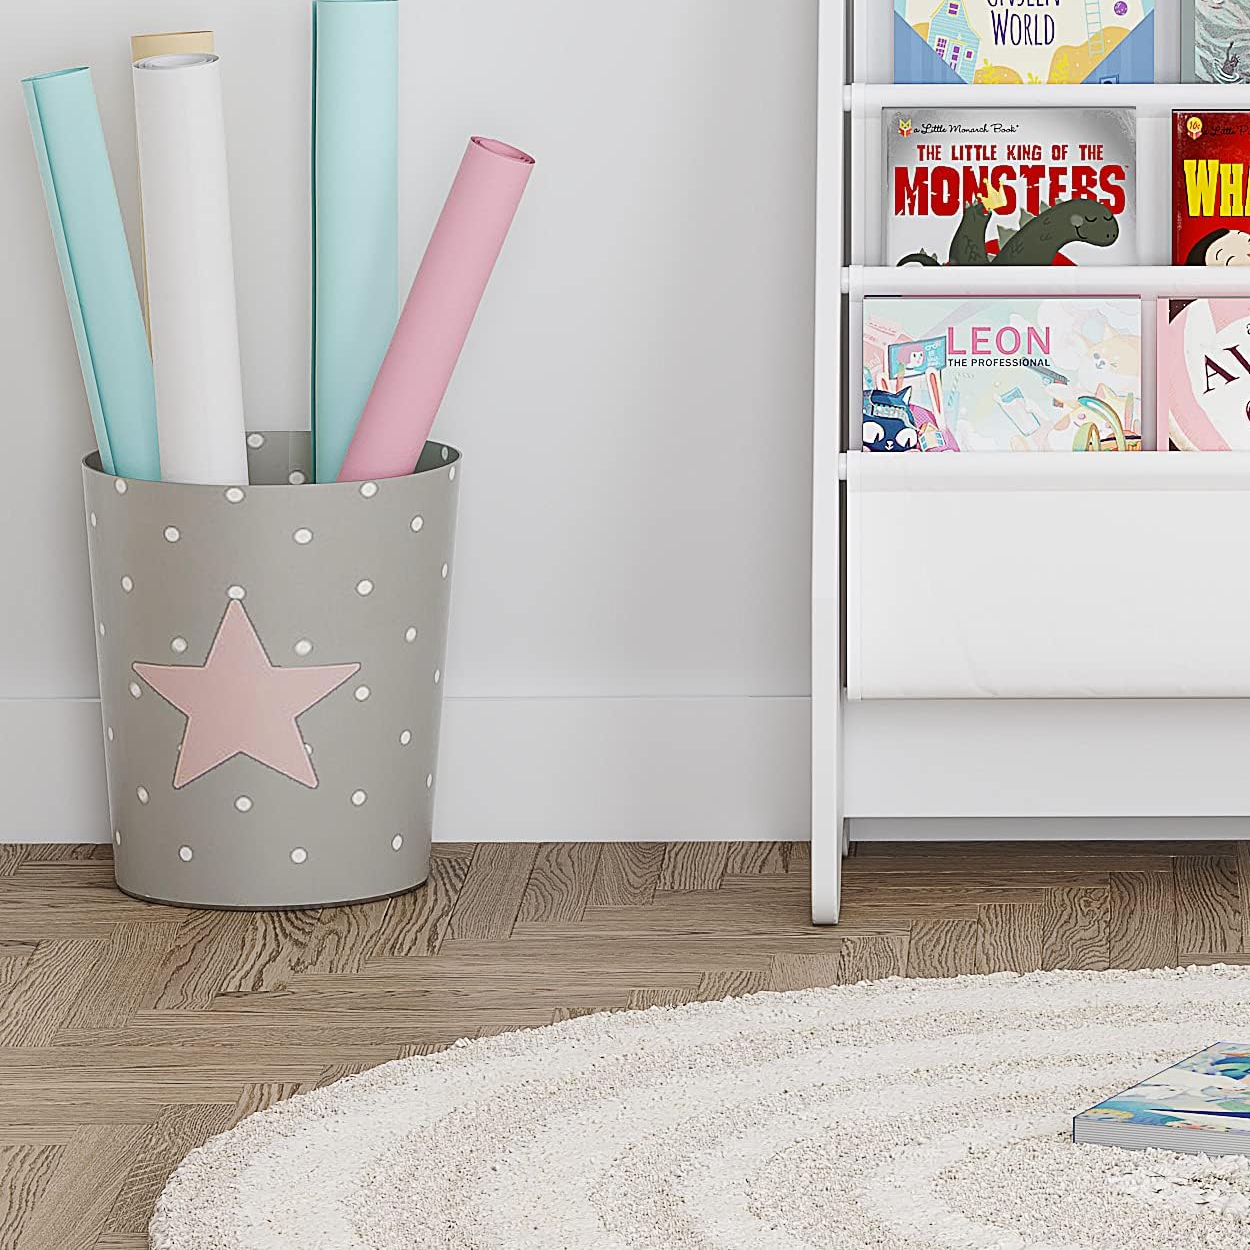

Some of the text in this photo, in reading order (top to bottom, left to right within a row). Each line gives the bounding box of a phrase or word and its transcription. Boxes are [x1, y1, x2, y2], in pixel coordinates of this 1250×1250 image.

[990, 9, 1055, 46] WORLD
[921, 123, 947, 134] Little
[948, 123, 989, 133] Monarch
[1210, 126, 1235, 136] Little
[917, 144, 1104, 161] THE LITTLE KING OF THE
[894, 165, 1126, 217] MONSTERS
[947, 326, 1050, 355] LEON
[947, 358, 1051, 367] THE PROFESSIONAL
